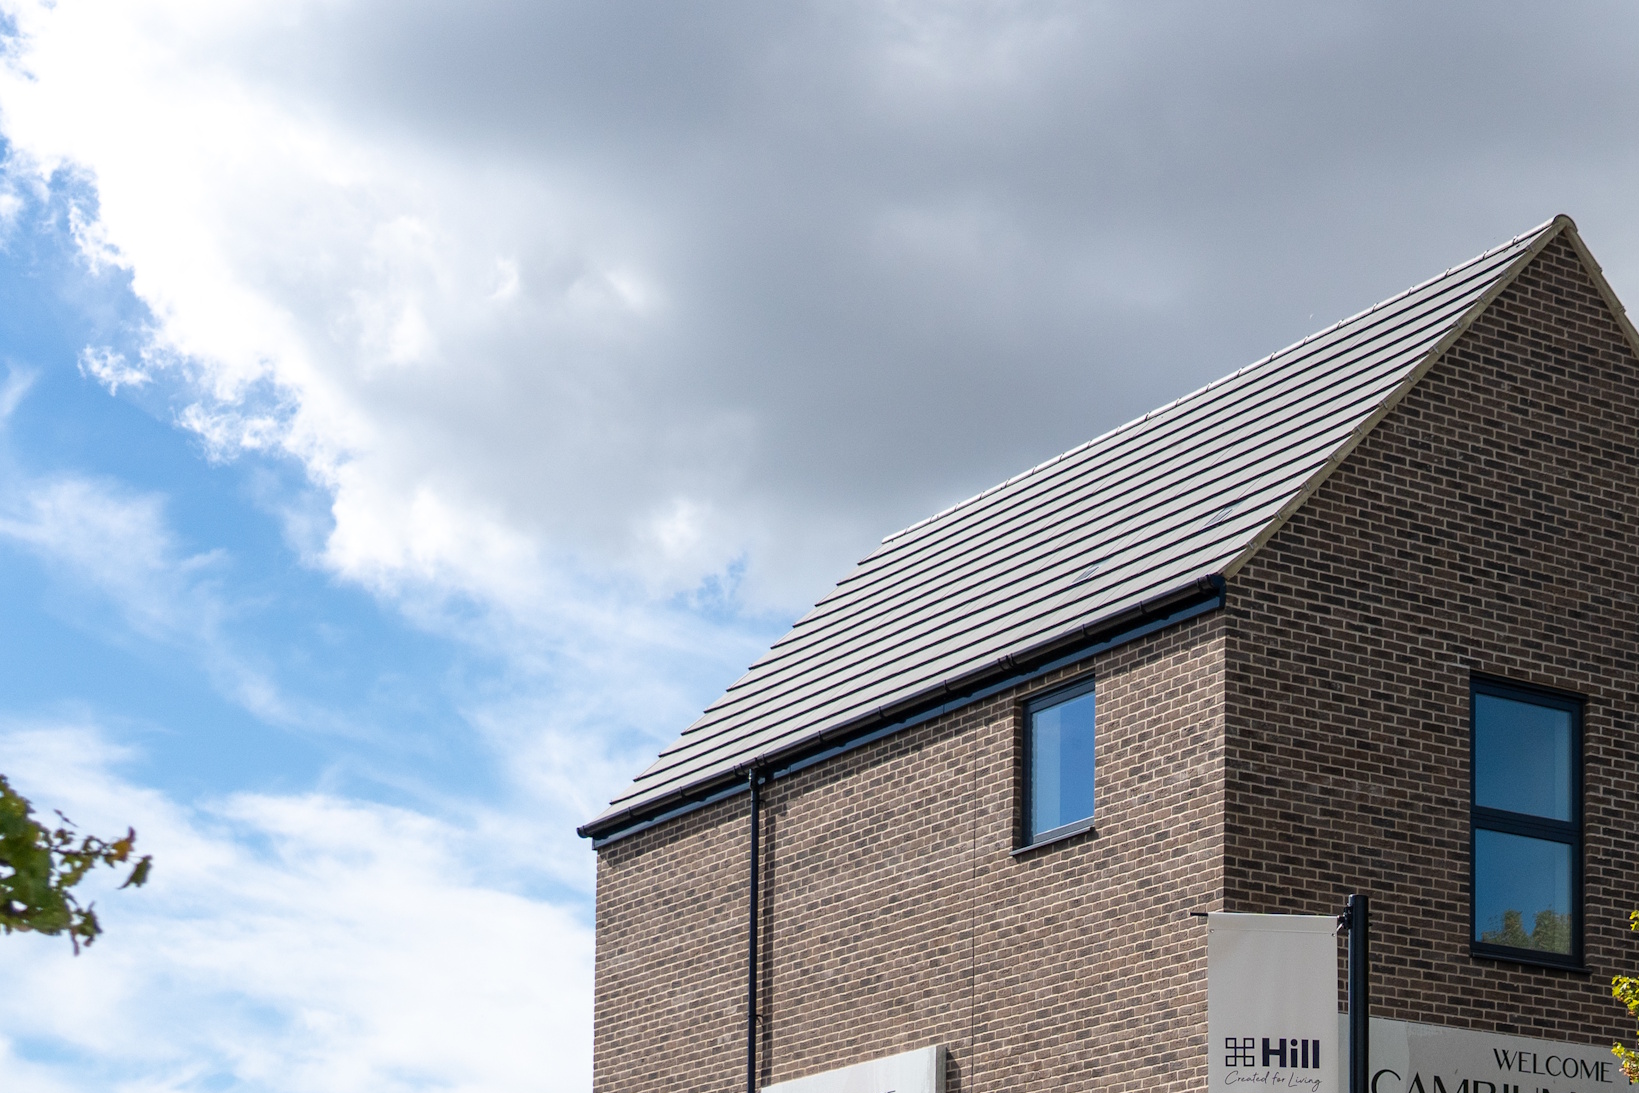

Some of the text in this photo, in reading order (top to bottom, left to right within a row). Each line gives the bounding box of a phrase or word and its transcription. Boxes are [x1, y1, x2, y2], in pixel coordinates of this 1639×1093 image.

[1262, 1038, 1320, 1068] Hill
[1493, 1048, 1613, 1083] WELCOME
[1225, 1071, 1322, 1092] Created for Living
